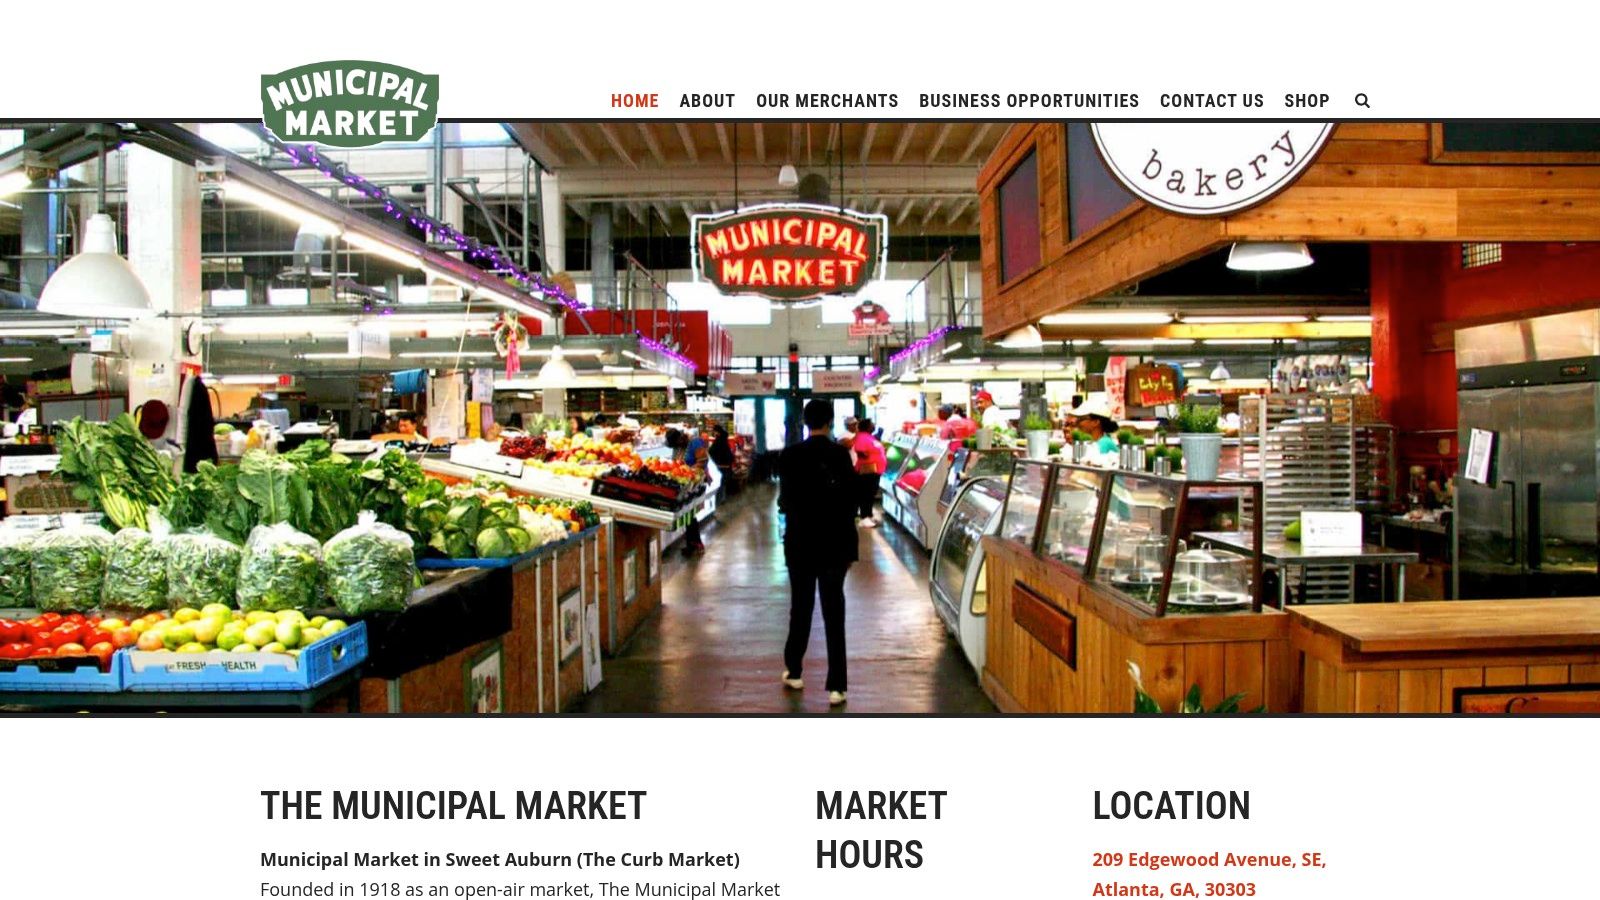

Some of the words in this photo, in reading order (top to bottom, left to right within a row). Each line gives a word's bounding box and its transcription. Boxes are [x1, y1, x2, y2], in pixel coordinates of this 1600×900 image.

[1142, 130, 1297, 196] bakery
[704, 218, 869, 262] MUNICIPAL
[722, 259, 859, 286] MARKET
[176, 661, 206, 671] FRESH
